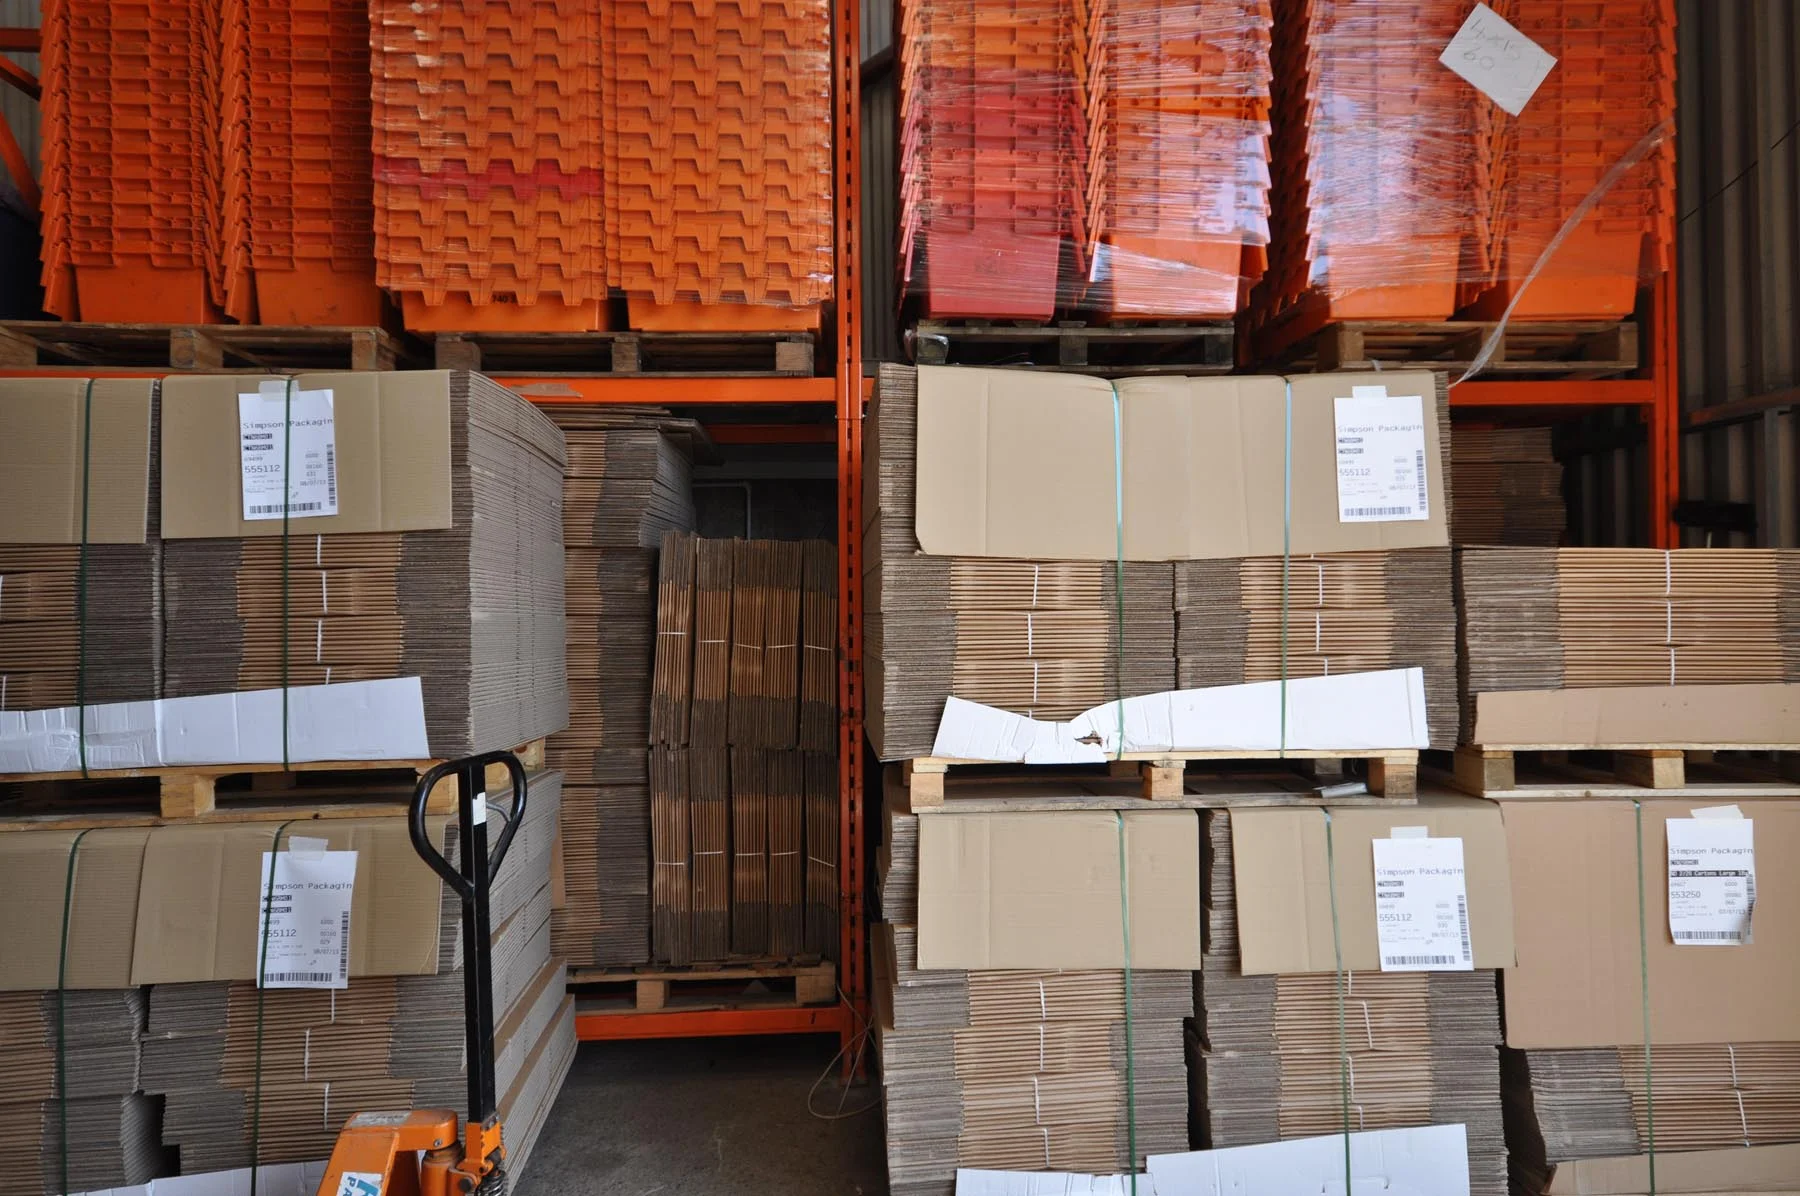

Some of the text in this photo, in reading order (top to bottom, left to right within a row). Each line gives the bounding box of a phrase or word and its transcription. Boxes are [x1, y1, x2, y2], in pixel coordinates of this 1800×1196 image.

[243, 421, 284, 430] Simpson
[244, 464, 281, 473] 555112
[1340, 468, 1371, 476] 555112
[1711, 847, 1753, 855] Packagin
[1376, 867, 1464, 876] Simpson Packagin
[263, 881, 353, 891] Smpson Packagin
[1671, 890, 1702, 899] 553250
[1379, 913, 1412, 921] 555112
